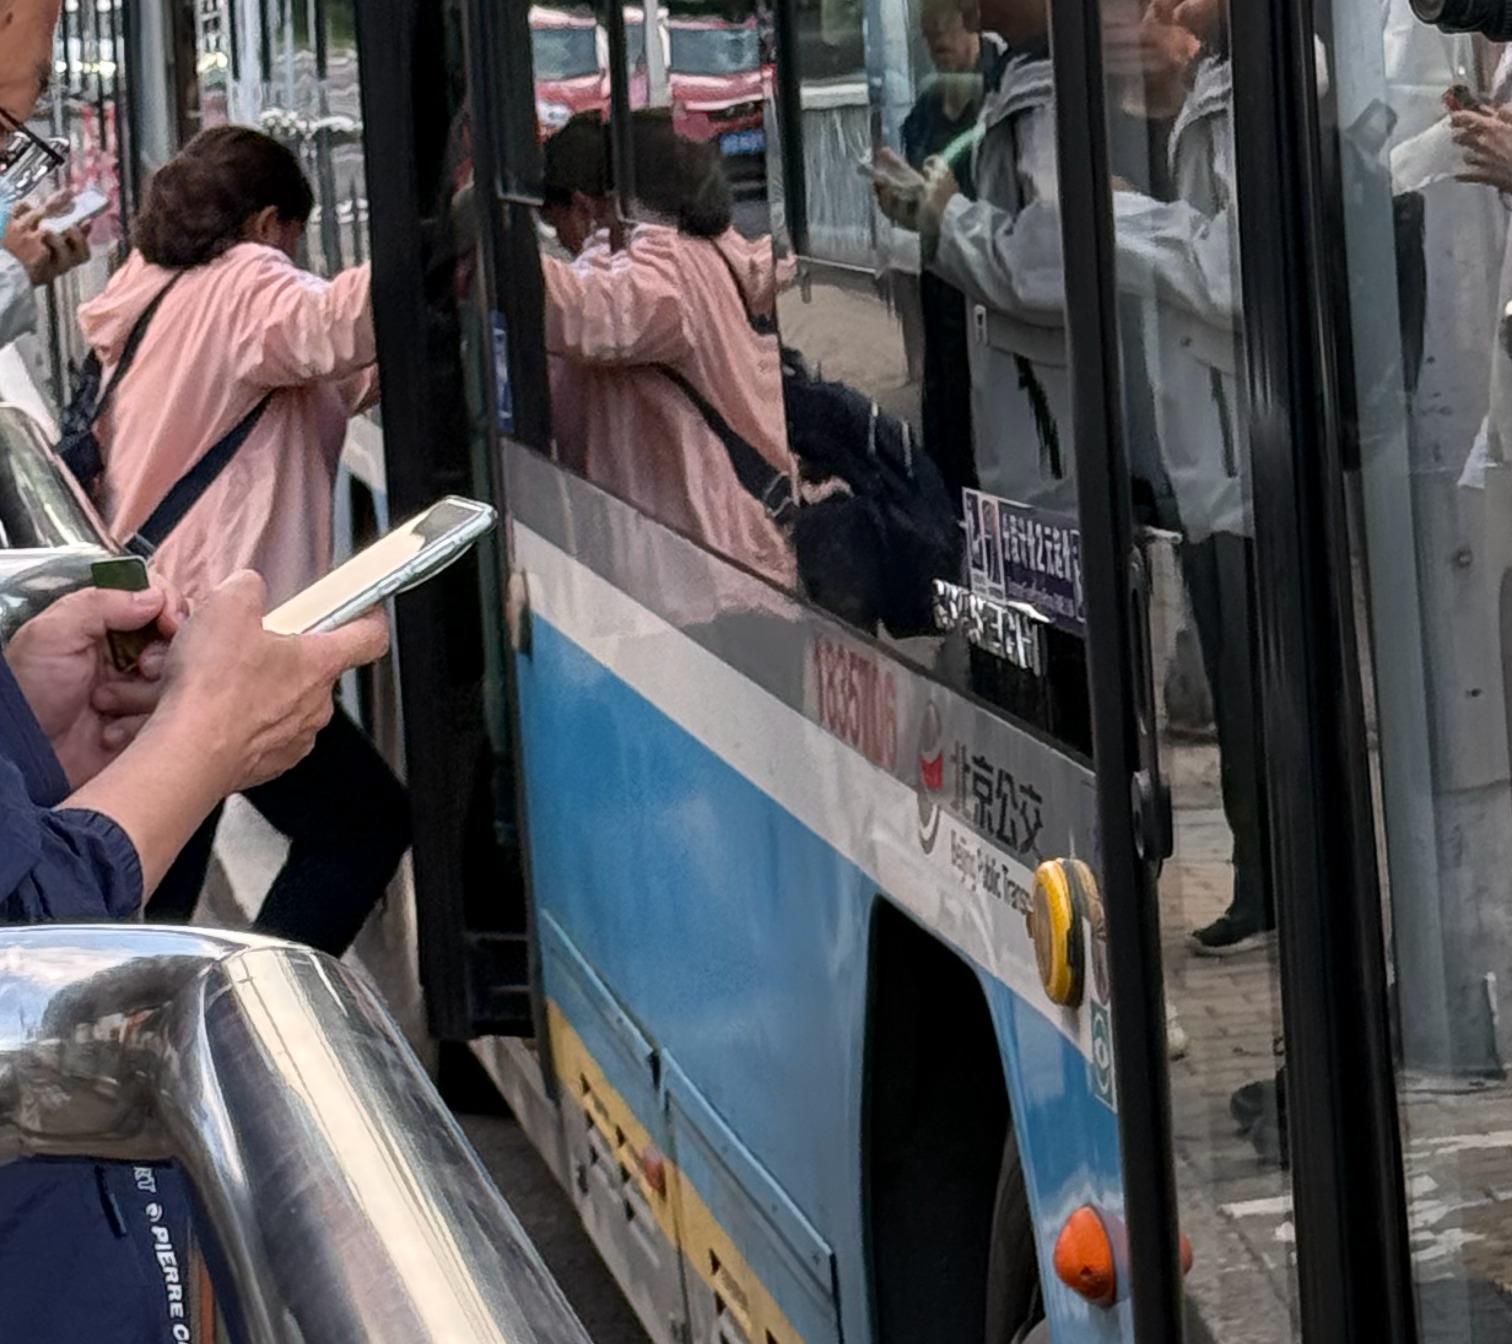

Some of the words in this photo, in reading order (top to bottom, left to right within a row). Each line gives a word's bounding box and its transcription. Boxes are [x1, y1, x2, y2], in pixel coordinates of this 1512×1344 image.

[950, 740, 1044, 854] 北京公交
[151, 1225, 185, 1319] PIERRE
